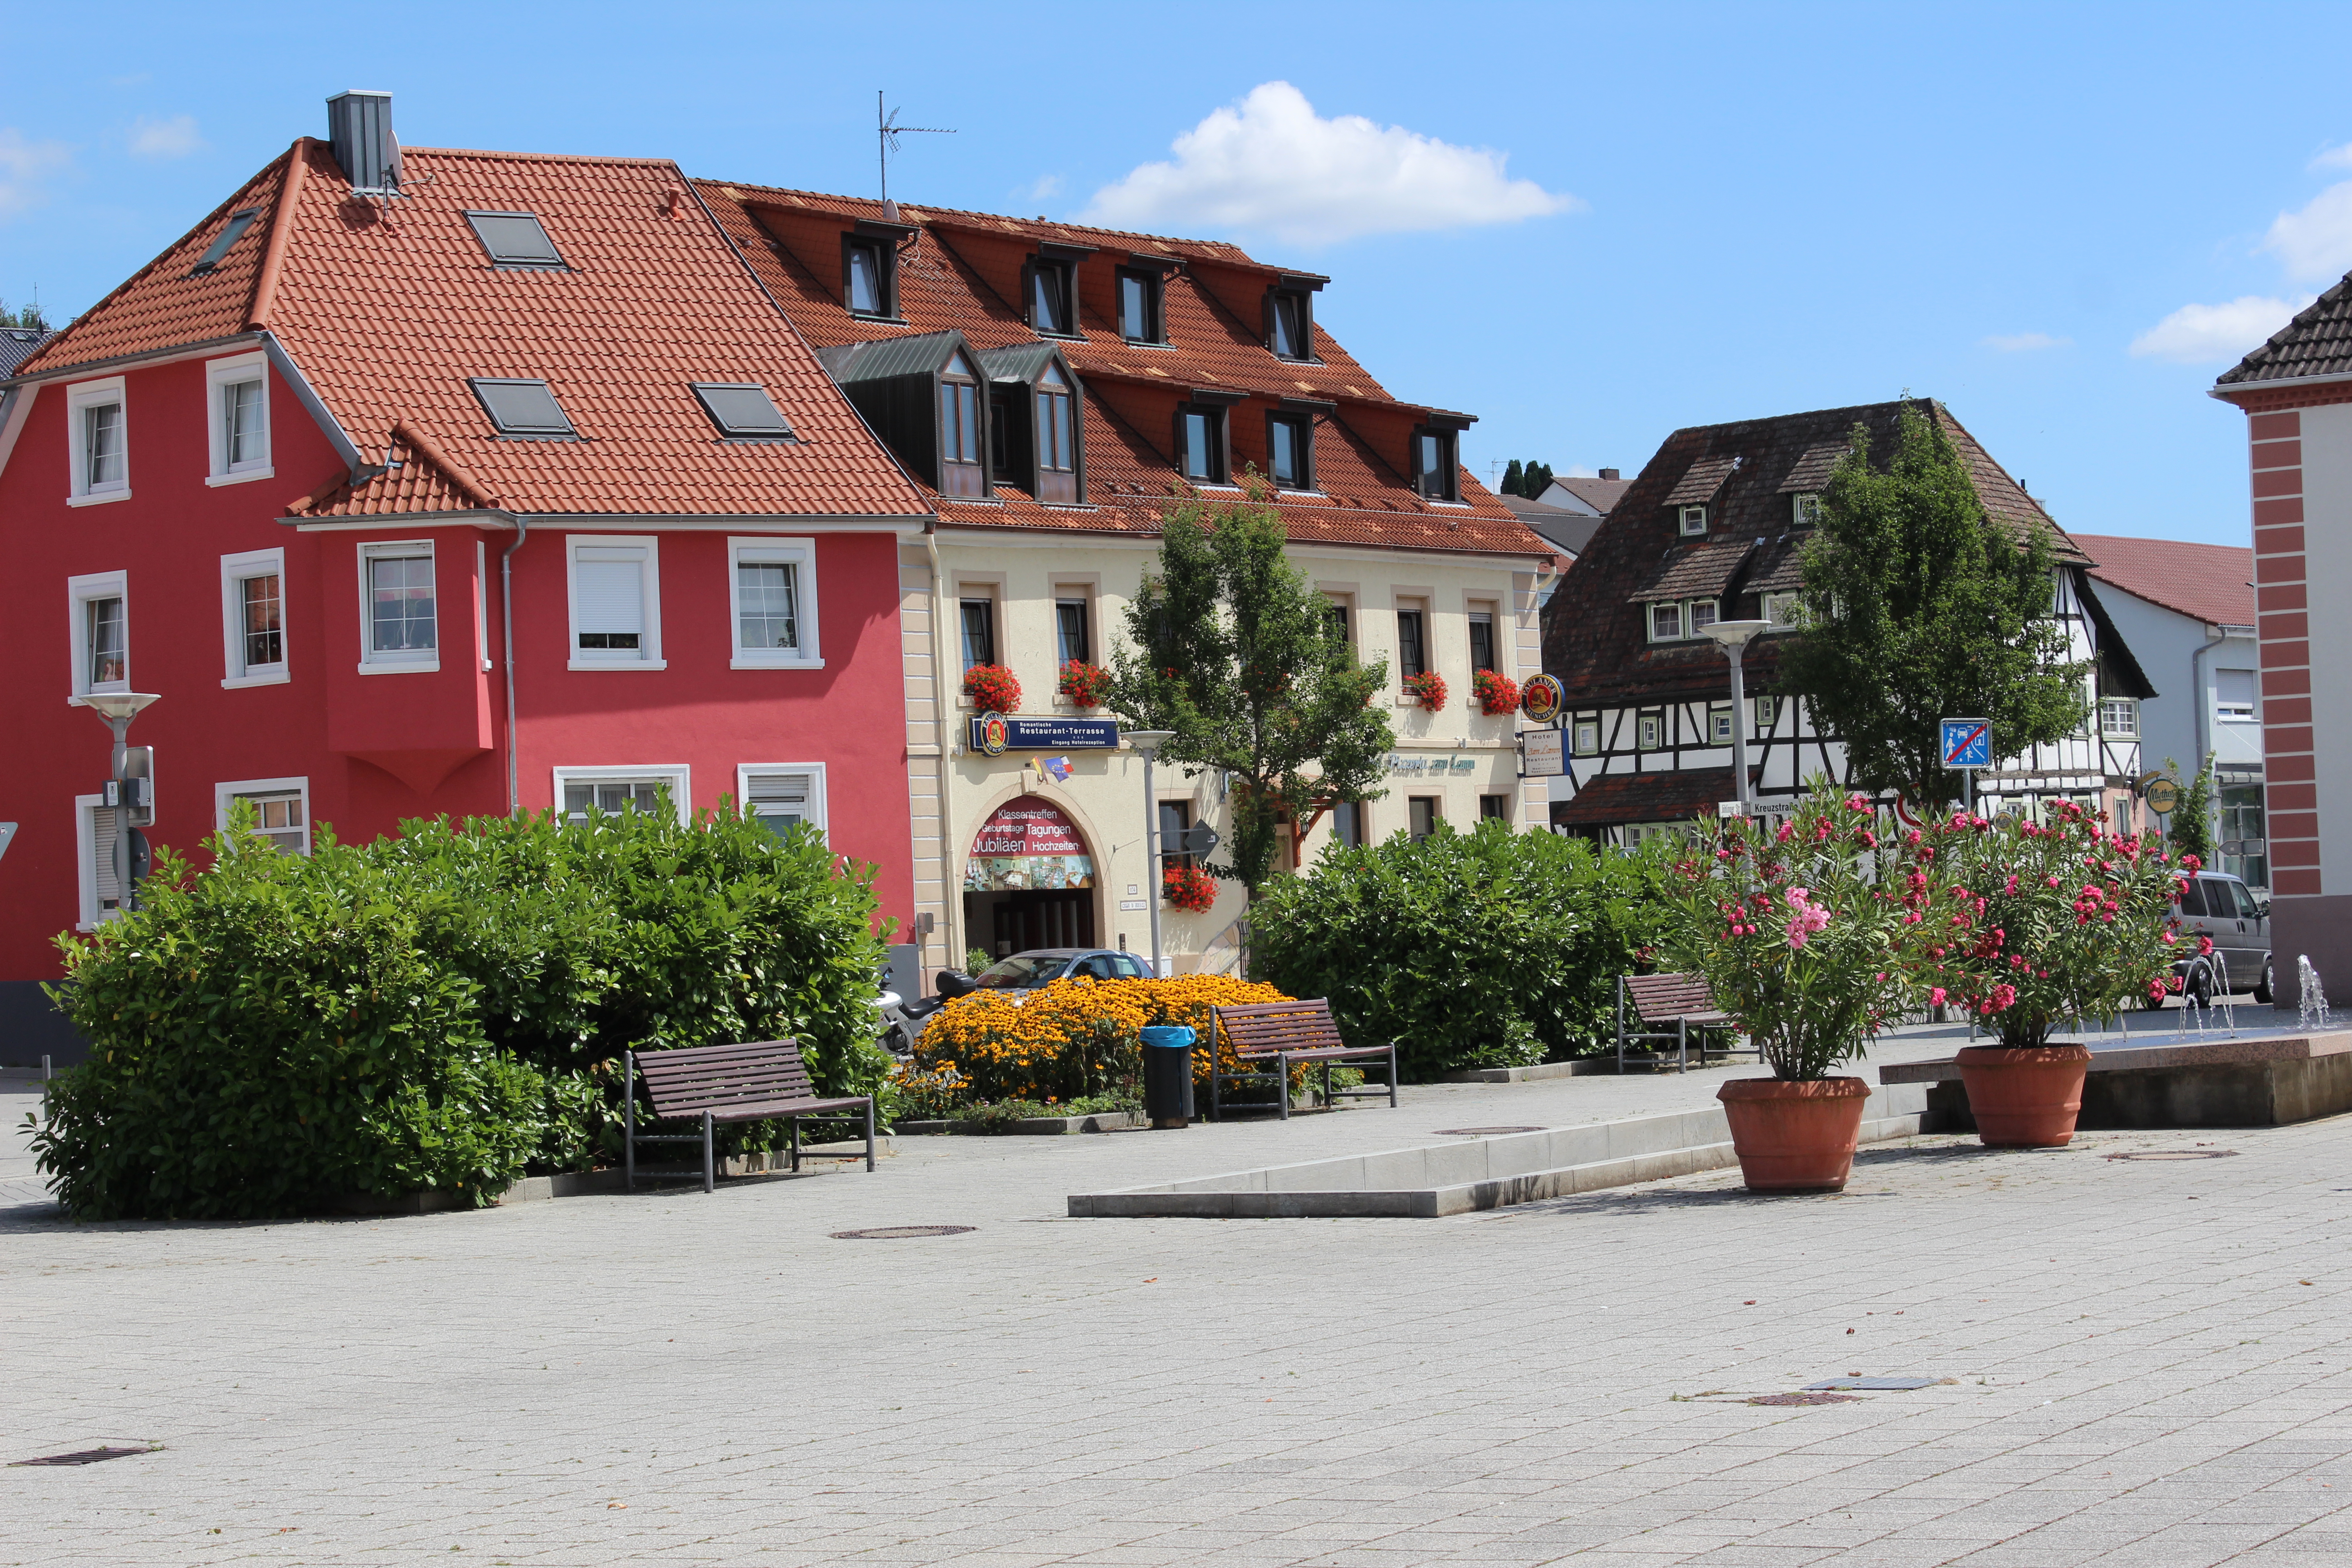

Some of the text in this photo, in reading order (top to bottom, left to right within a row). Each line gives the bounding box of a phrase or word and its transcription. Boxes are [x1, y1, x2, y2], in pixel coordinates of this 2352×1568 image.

[1523, 677, 1557, 696] PAULANER
[1526, 706, 1555, 719] MÜNCHEN
[983, 713, 1007, 729] PAULANER
[1388, 754, 1428, 769] Pizzeria
[1431, 759, 1448, 769] zum
[1451, 754, 1475, 769] Lamm
[2149, 788, 2175, 803] Mythos
[998, 809, 1057, 819] Klassentreffen
[982, 824, 1024, 833] Geburtstage
[1025, 823, 1071, 838] Tagungen
[972, 837, 1026, 853] Jubiläen
[1032, 841, 1078, 851] Hochzeiten
